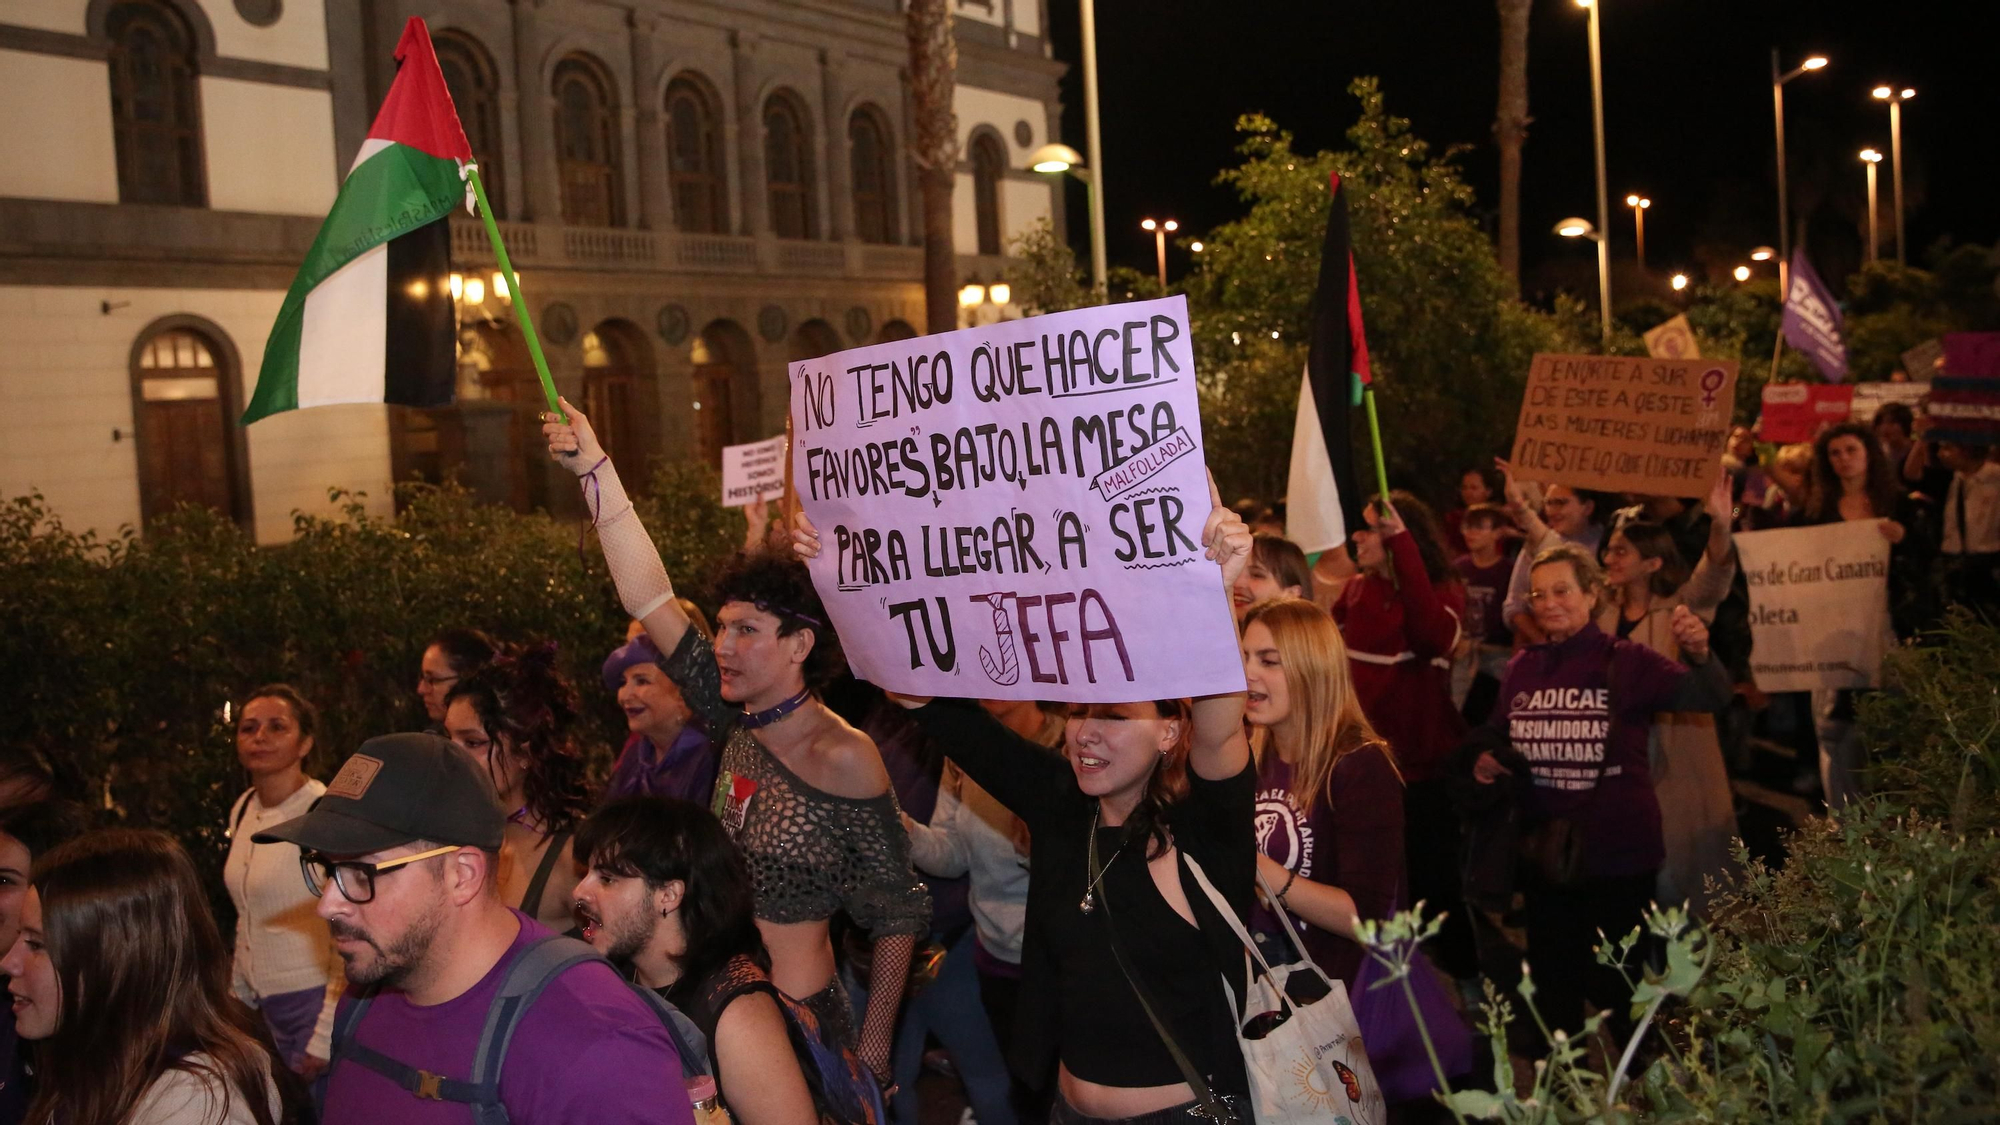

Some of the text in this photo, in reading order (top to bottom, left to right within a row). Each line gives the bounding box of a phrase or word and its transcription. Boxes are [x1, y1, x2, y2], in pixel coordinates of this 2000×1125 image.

[847, 351, 953, 419] TENGO
[971, 341, 1042, 402] QUE
[1042, 314, 1180, 395] HACER
[1629, 364, 1644, 383] A
[1652, 365, 1688, 387] SUR
[1531, 385, 1559, 408] DE
[1564, 387, 1608, 409] ESTE
[1613, 390, 1629, 407] A
[1022, 416, 1067, 477] LA
[1073, 401, 1177, 478] MESA
[1524, 412, 1559, 431] LAS
[1103, 436, 1188, 493] MALFOLLADA
[833, 525, 911, 585] PARA
[1109, 495, 1198, 562] SER
[1767, 562, 1785, 585] de
[1788, 560, 1821, 584] Gran
[1825, 555, 1886, 582] Canaria
[970, 588, 1135, 687] JEFA
[1527, 688, 1609, 710] ADICAE
